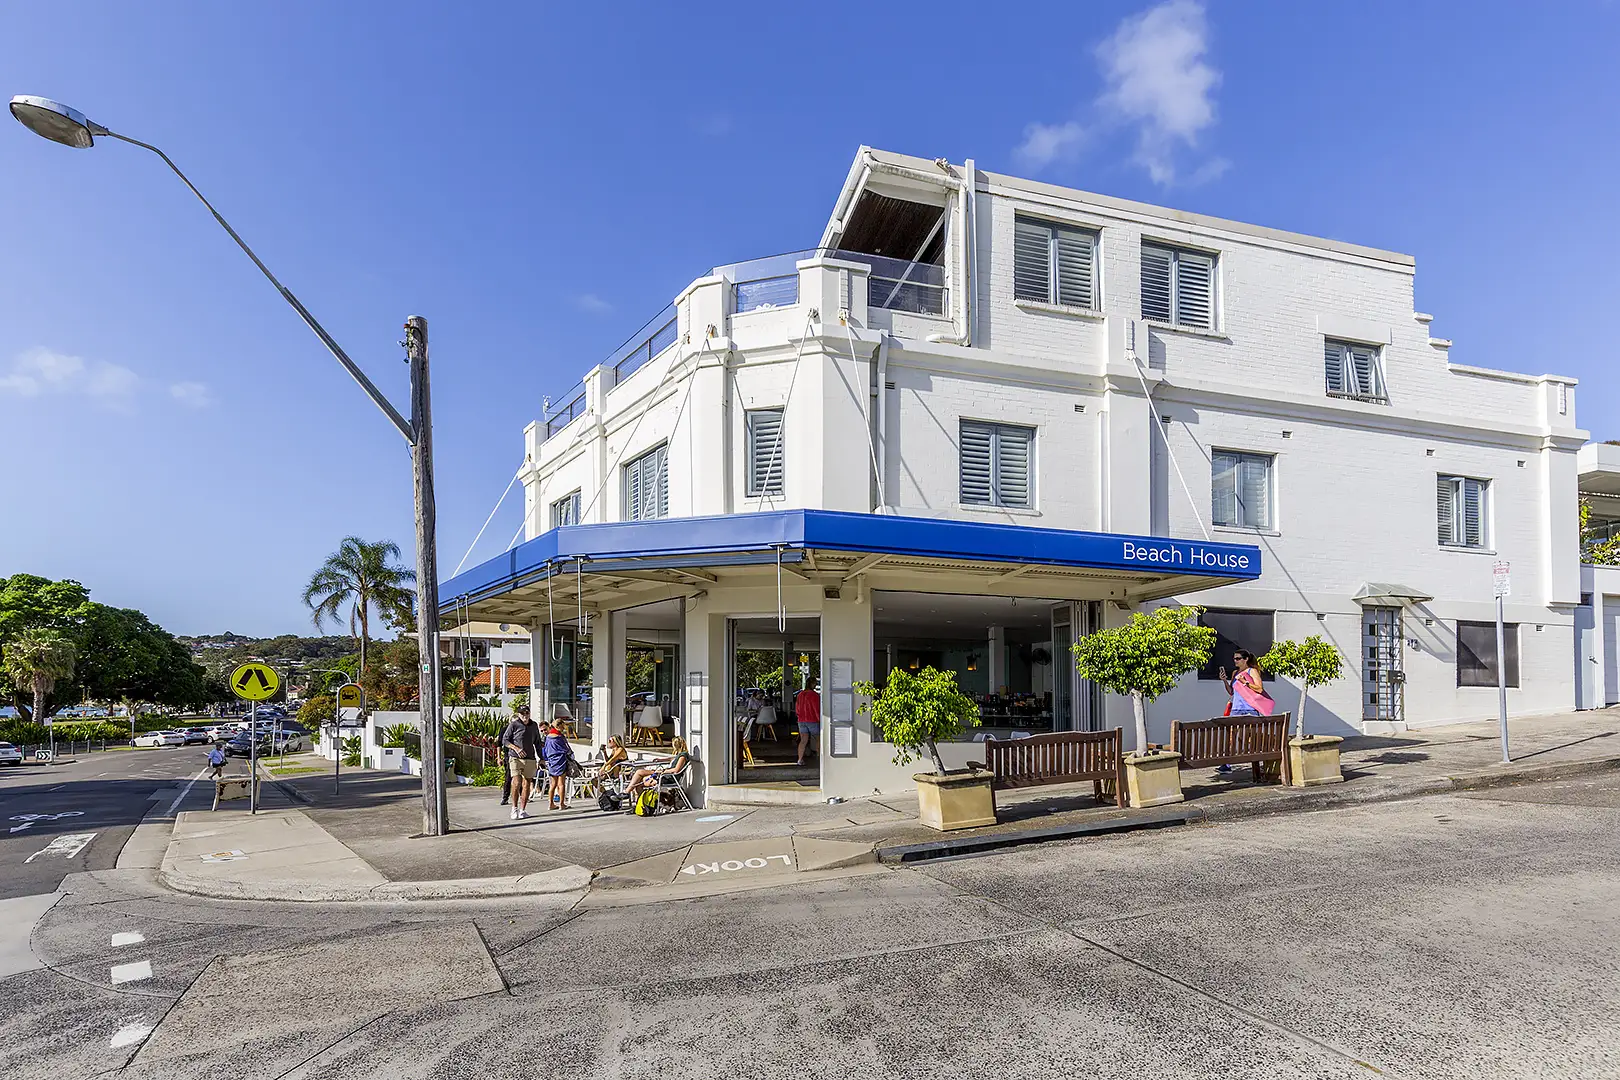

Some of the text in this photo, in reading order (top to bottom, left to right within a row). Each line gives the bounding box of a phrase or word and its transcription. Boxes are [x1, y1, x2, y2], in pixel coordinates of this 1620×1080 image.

[1123, 542, 1249, 568] Beach House
[697, 854, 791, 875] LOOK
